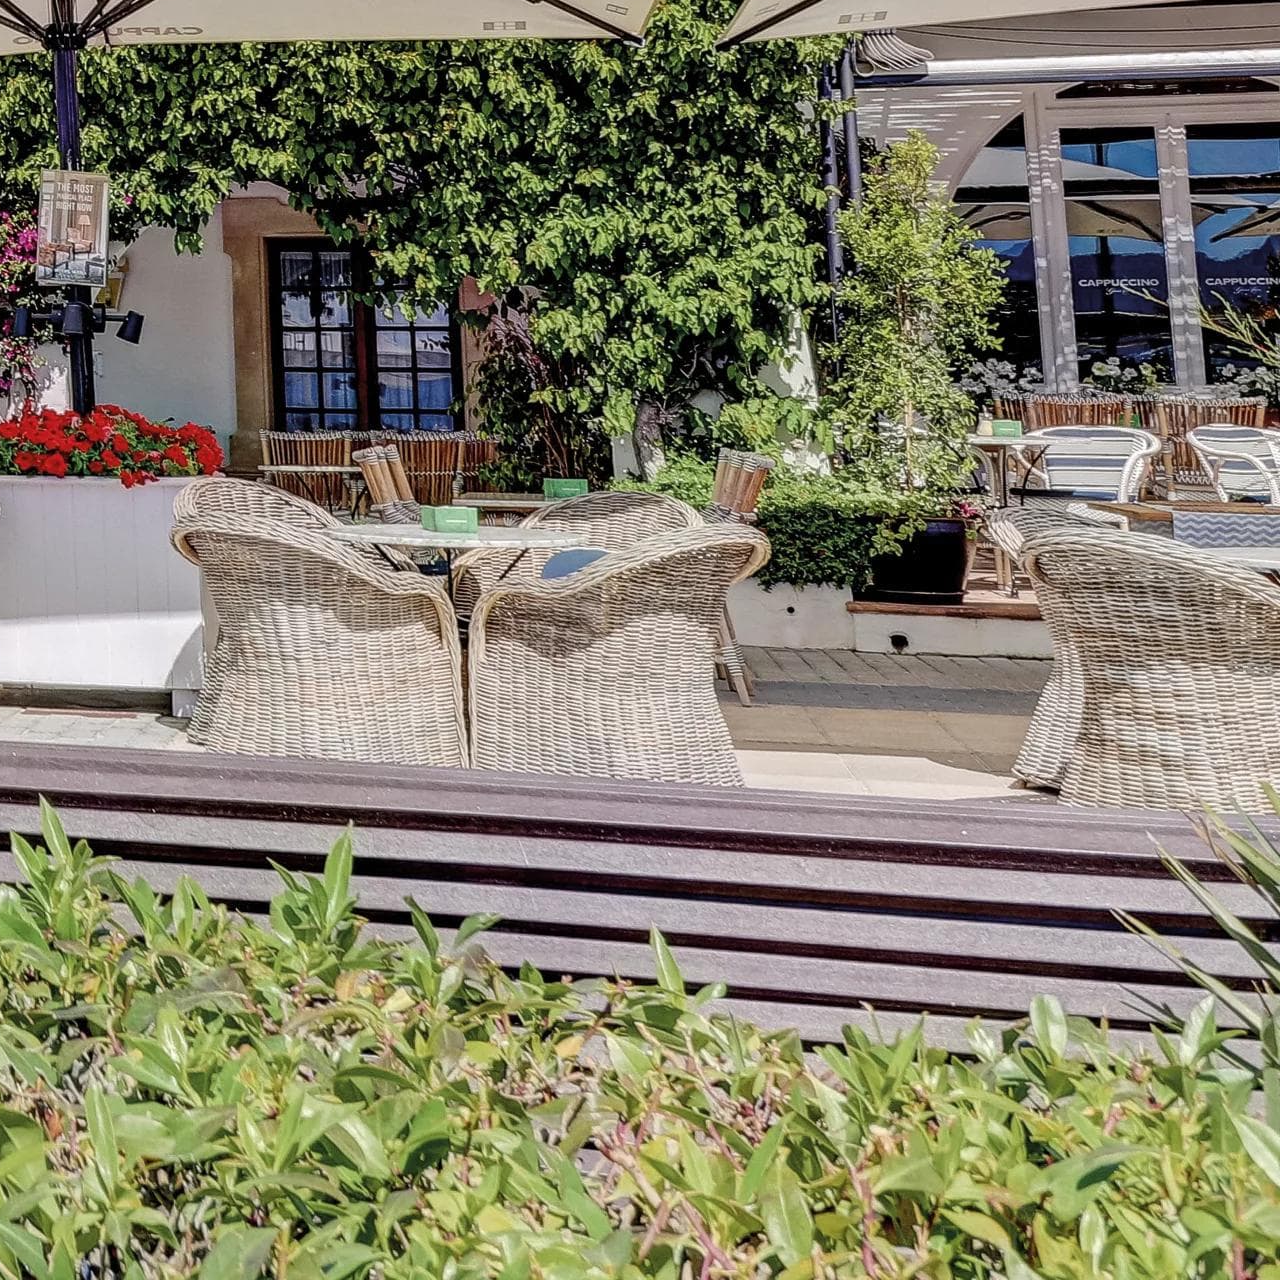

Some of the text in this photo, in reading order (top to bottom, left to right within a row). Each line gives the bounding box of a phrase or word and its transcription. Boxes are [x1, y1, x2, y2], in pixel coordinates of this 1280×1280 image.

[56, 182, 94, 194] THE MOST
[76, 202, 93, 212] NOW
[1078, 278, 1160, 287] CAPPUCCINO
[1205, 277, 1280, 286] CAPPUCCIN
